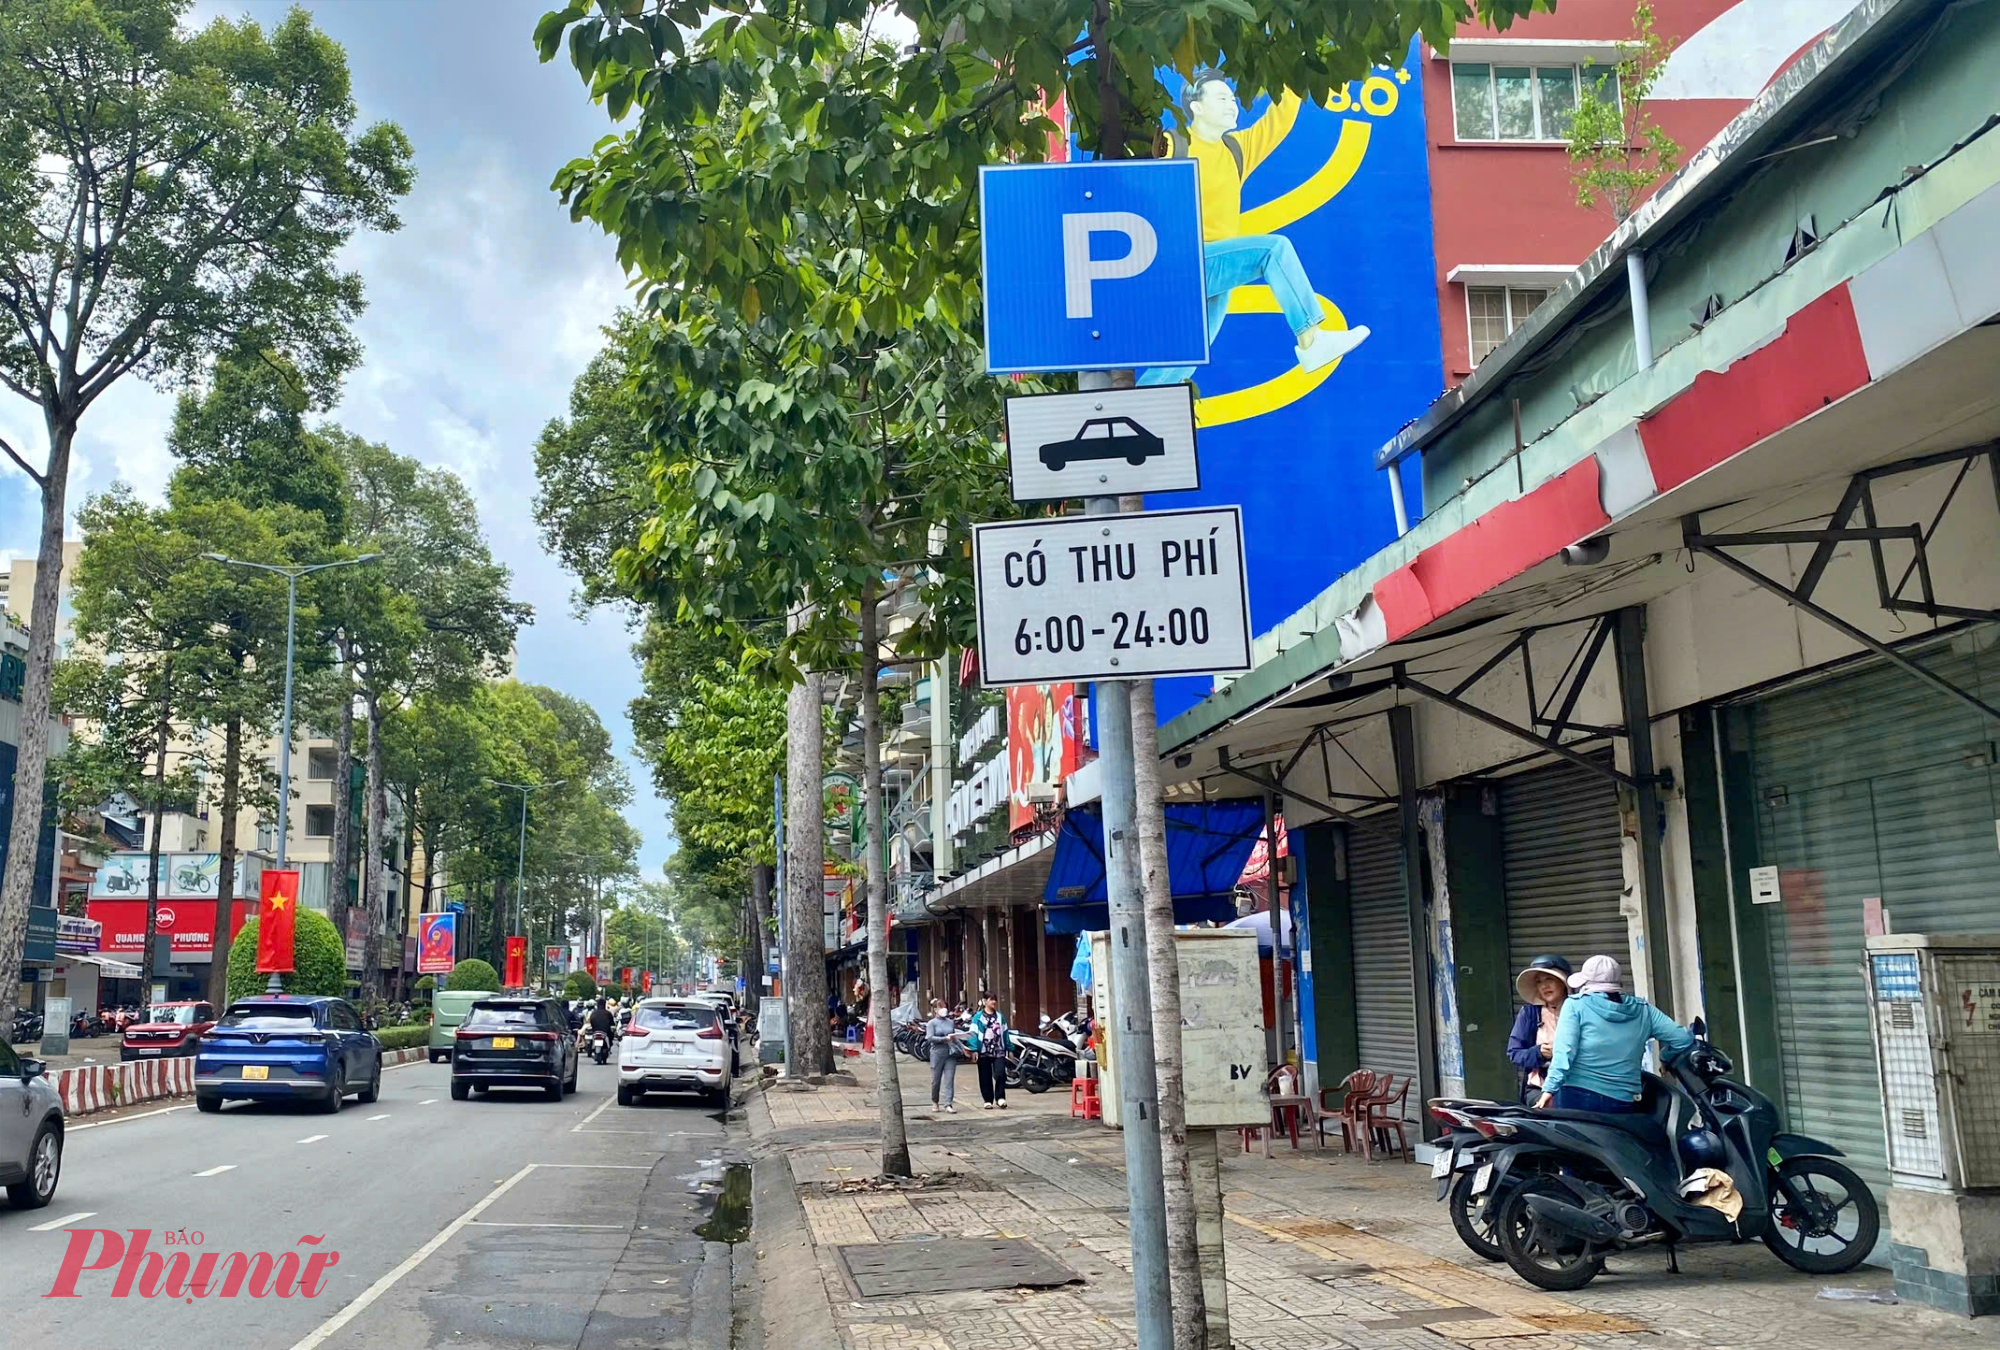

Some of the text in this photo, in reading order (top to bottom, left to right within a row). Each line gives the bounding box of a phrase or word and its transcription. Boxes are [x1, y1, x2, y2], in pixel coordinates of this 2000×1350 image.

[1062, 211, 1158, 320] P
[1004, 526, 1219, 588] CÓ THU PHÍ
[115, 933, 145, 944] QUANG
[1230, 1064, 1252, 1080] BV
